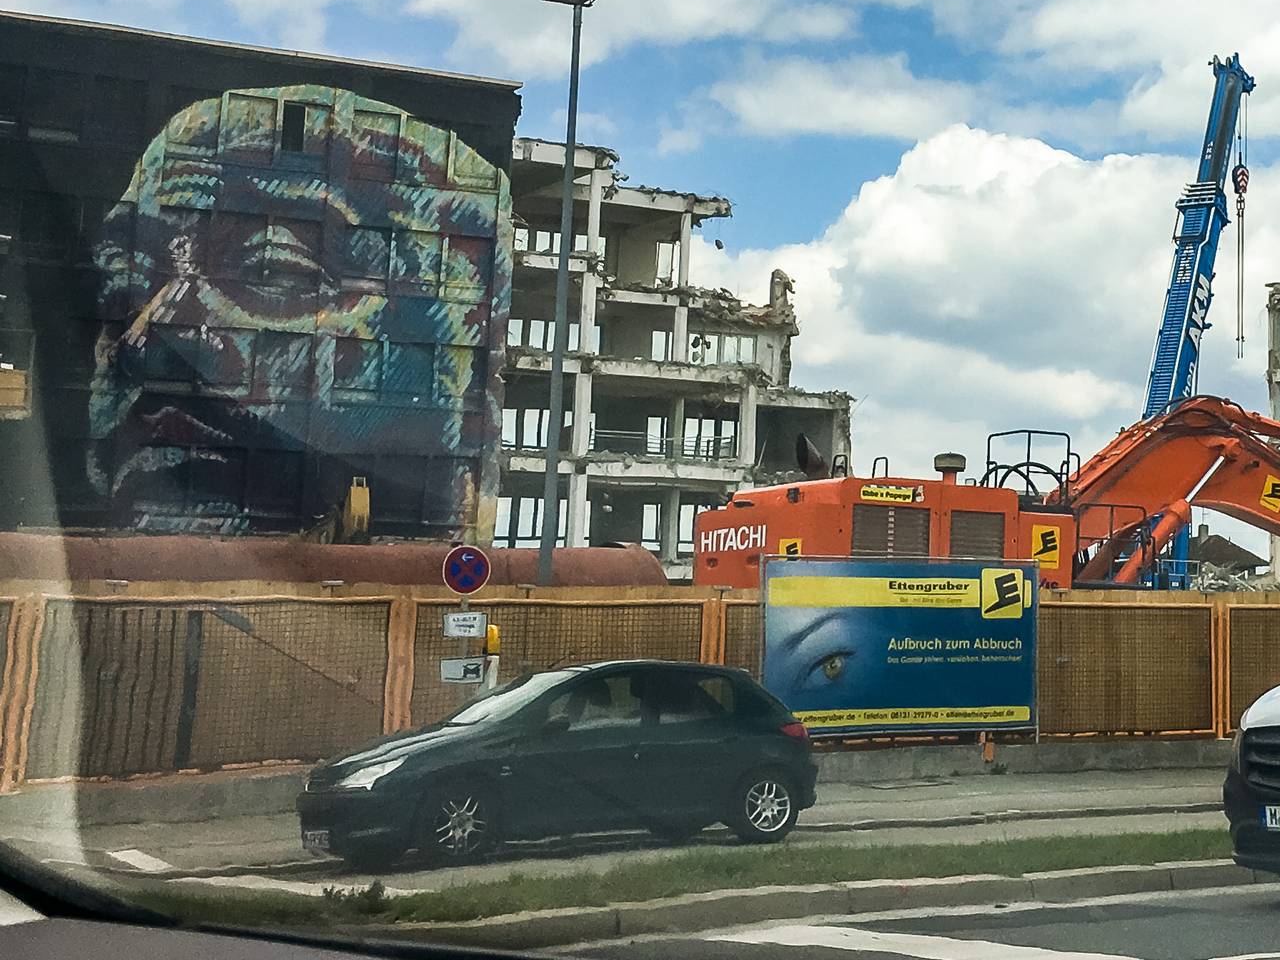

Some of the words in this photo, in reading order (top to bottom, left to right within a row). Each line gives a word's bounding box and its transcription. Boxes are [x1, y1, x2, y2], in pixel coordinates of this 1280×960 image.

[700, 524, 767, 553] HITACHI
[888, 580, 970, 593] Ettengruber
[888, 637, 942, 651] Aufbruch
[945, 640, 970, 650] zum
[974, 637, 1022, 650] Abbruch
